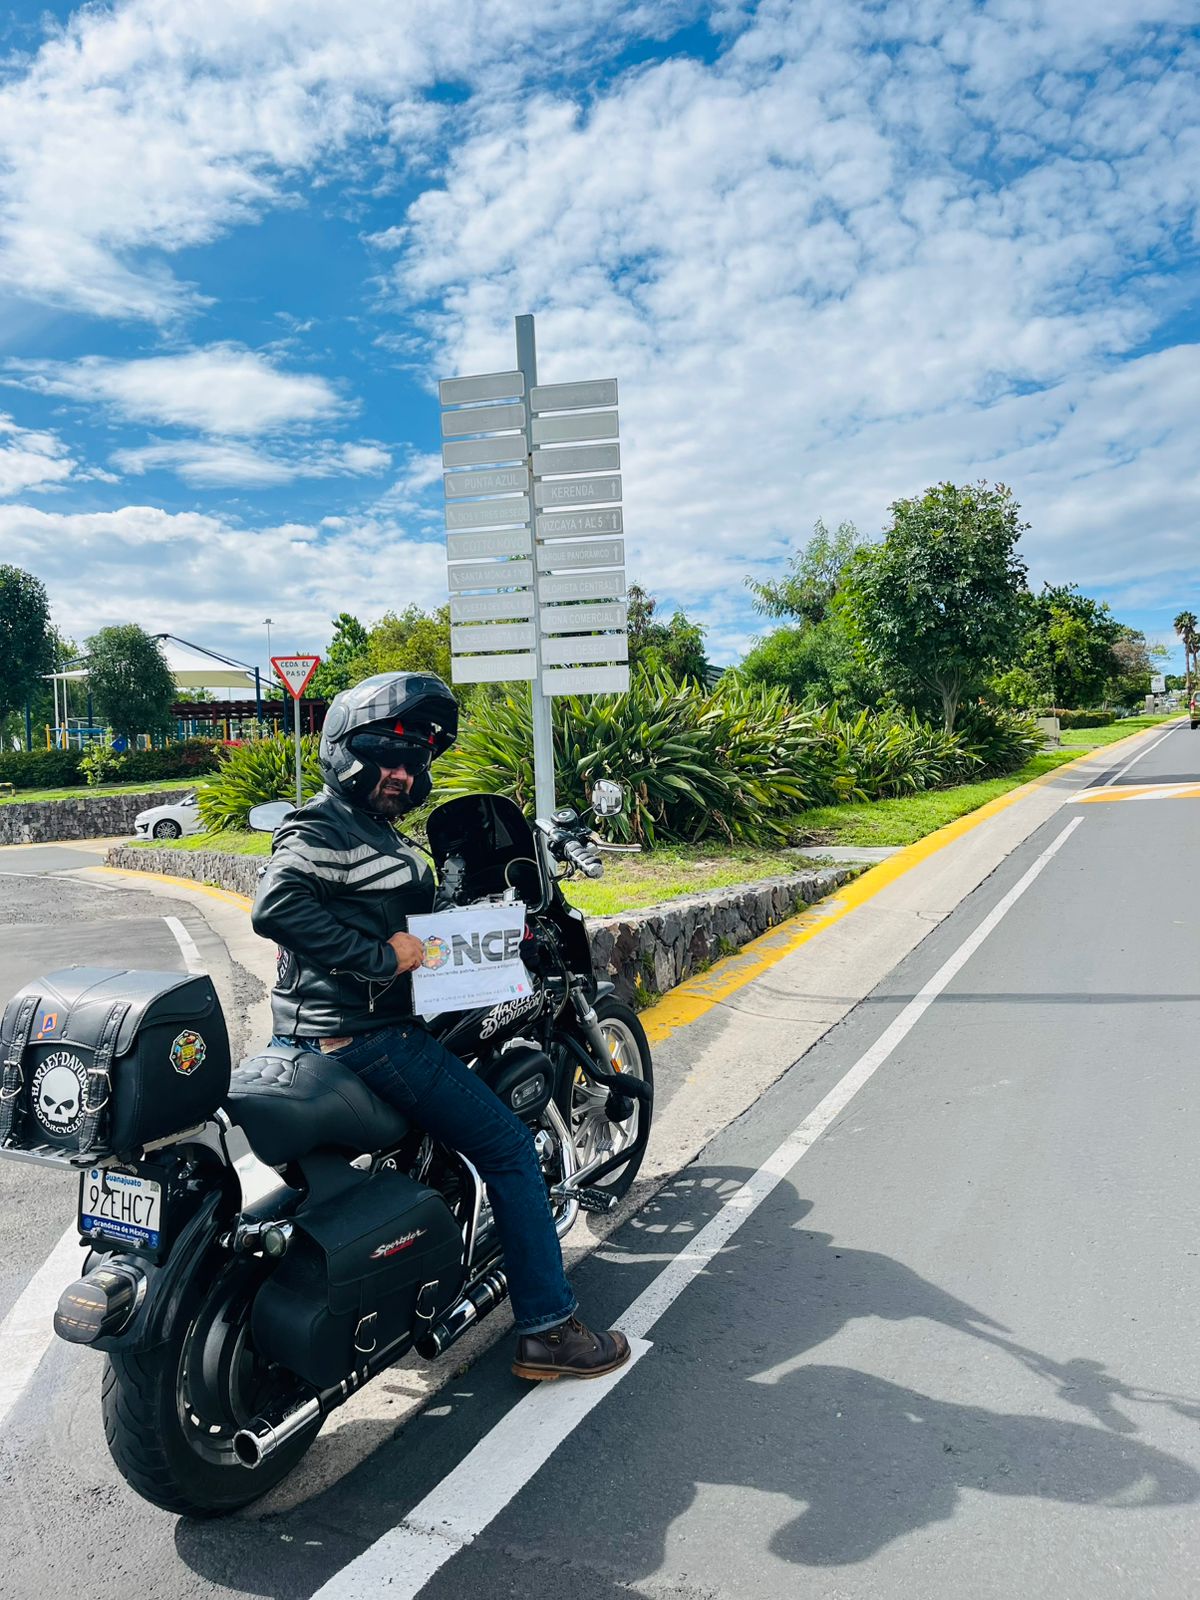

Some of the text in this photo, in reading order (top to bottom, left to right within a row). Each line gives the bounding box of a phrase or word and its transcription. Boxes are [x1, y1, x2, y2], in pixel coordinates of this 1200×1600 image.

[464, 474, 519, 489] PUNTA AZUL
[551, 485, 594, 498] KERENDA
[542, 519, 576, 531] VIZCAYA
[585, 518, 596, 528] AL
[598, 516, 603, 527] 5
[579, 580, 614, 592] CENTRAL
[569, 612, 614, 624] COMERCIAL
[34, 1103, 85, 1134] MOTORCYCLES
[106, 1173, 142, 1187] Guanajuato
[93, 1219, 120, 1232] Grandeza
[120, 1226, 129, 1234] de
